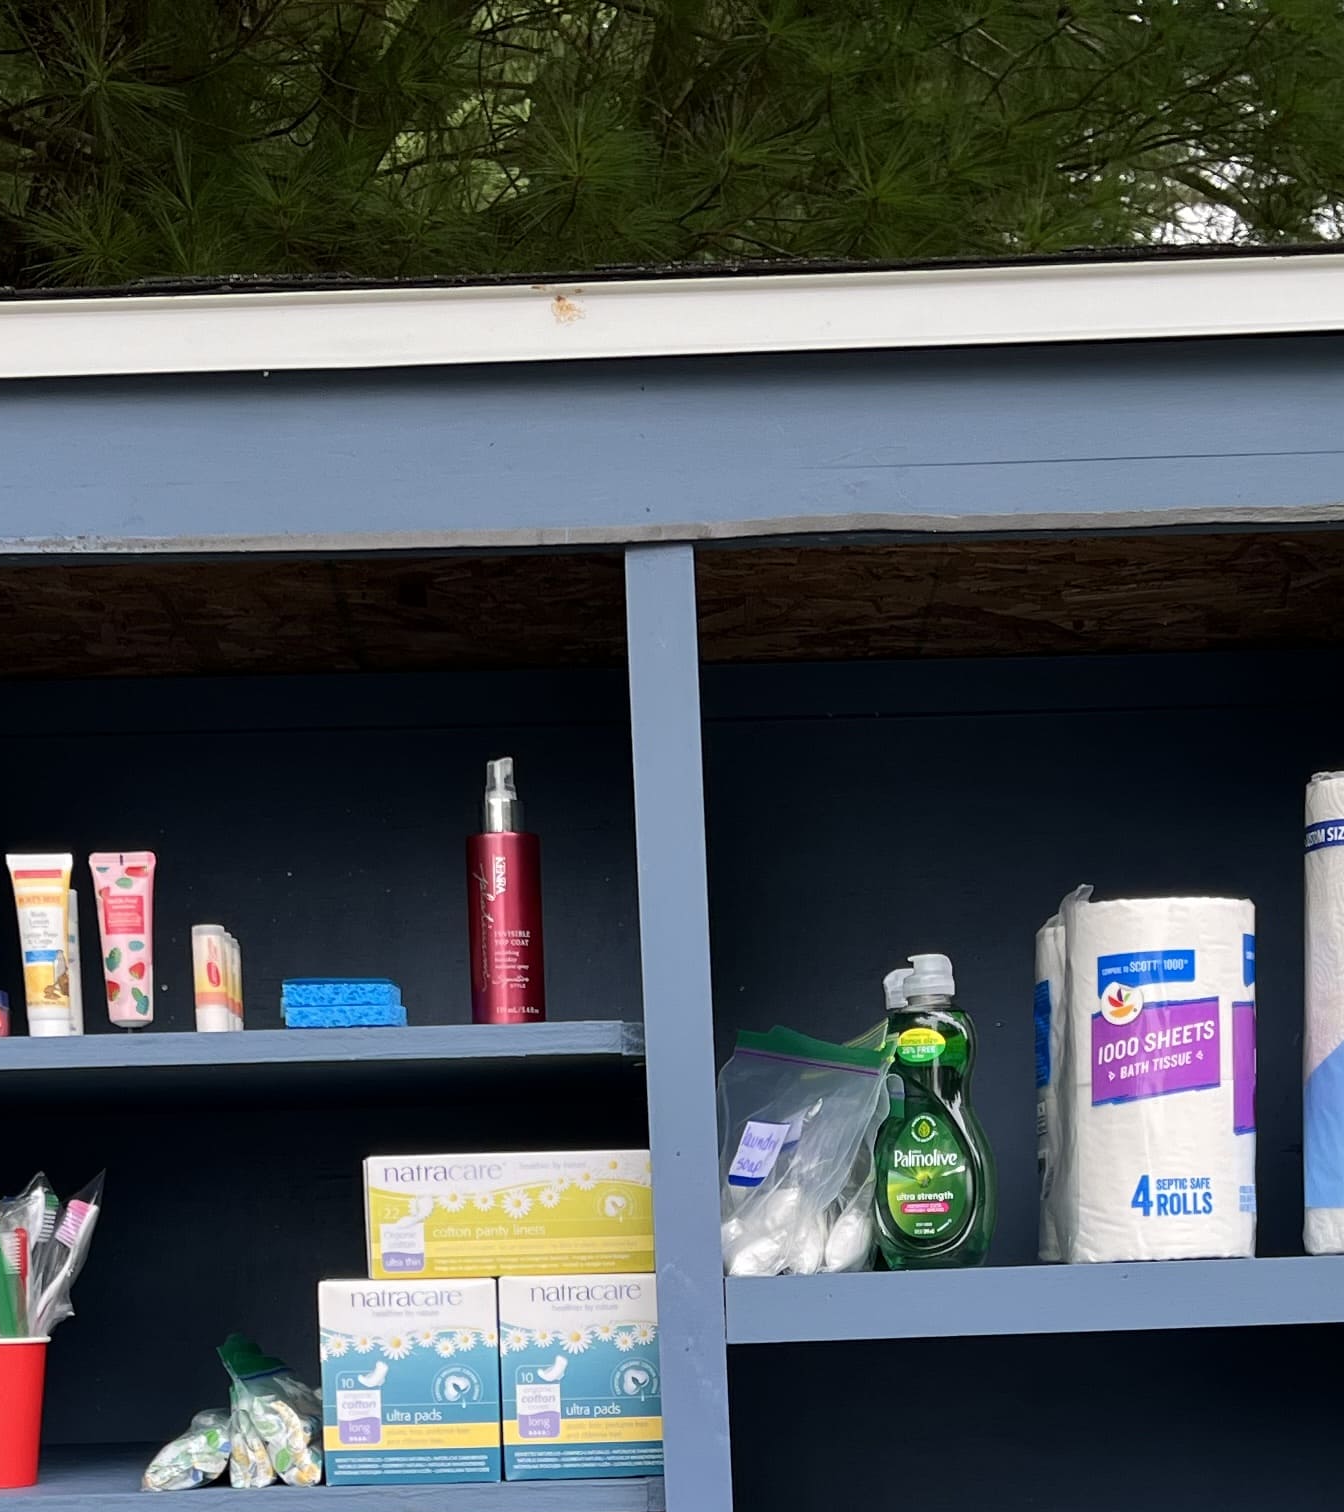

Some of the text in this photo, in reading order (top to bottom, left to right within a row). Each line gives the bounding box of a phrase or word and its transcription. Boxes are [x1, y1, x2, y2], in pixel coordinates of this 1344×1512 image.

[1305, 829, 1325, 847] USTOM
[495, 856, 506, 895] KENRA
[494, 930, 531, 938] INVISIBLE
[494, 938, 530, 947] TOP COAT
[1098, 1020, 1215, 1065] 1000 SHEETS
[1119, 1051, 1193, 1080] BATH TISSUE
[893, 1148, 958, 1168] Palmolive
[383, 1162, 503, 1184] natracare
[896, 1191, 954, 1202] ultra strength
[1131, 1174, 1211, 1217] 4 SEPTIC SAFE
[1156, 1191, 1213, 1216] ROLLS
[383, 1207, 400, 1219] 22
[432, 1223, 546, 1239] cotton panty liners
[350, 1288, 463, 1308] natracare
[530, 1283, 642, 1303] natracare
[341, 1378, 355, 1389] 10
[520, 1372, 534, 1383] 10
[341, 1399, 377, 1410] cotton
[521, 1393, 556, 1404] cotton
[386, 1409, 443, 1425] ultra pads
[566, 1402, 622, 1418] ultra pads
[348, 1422, 372, 1435] long
[528, 1417, 551, 1429] long
